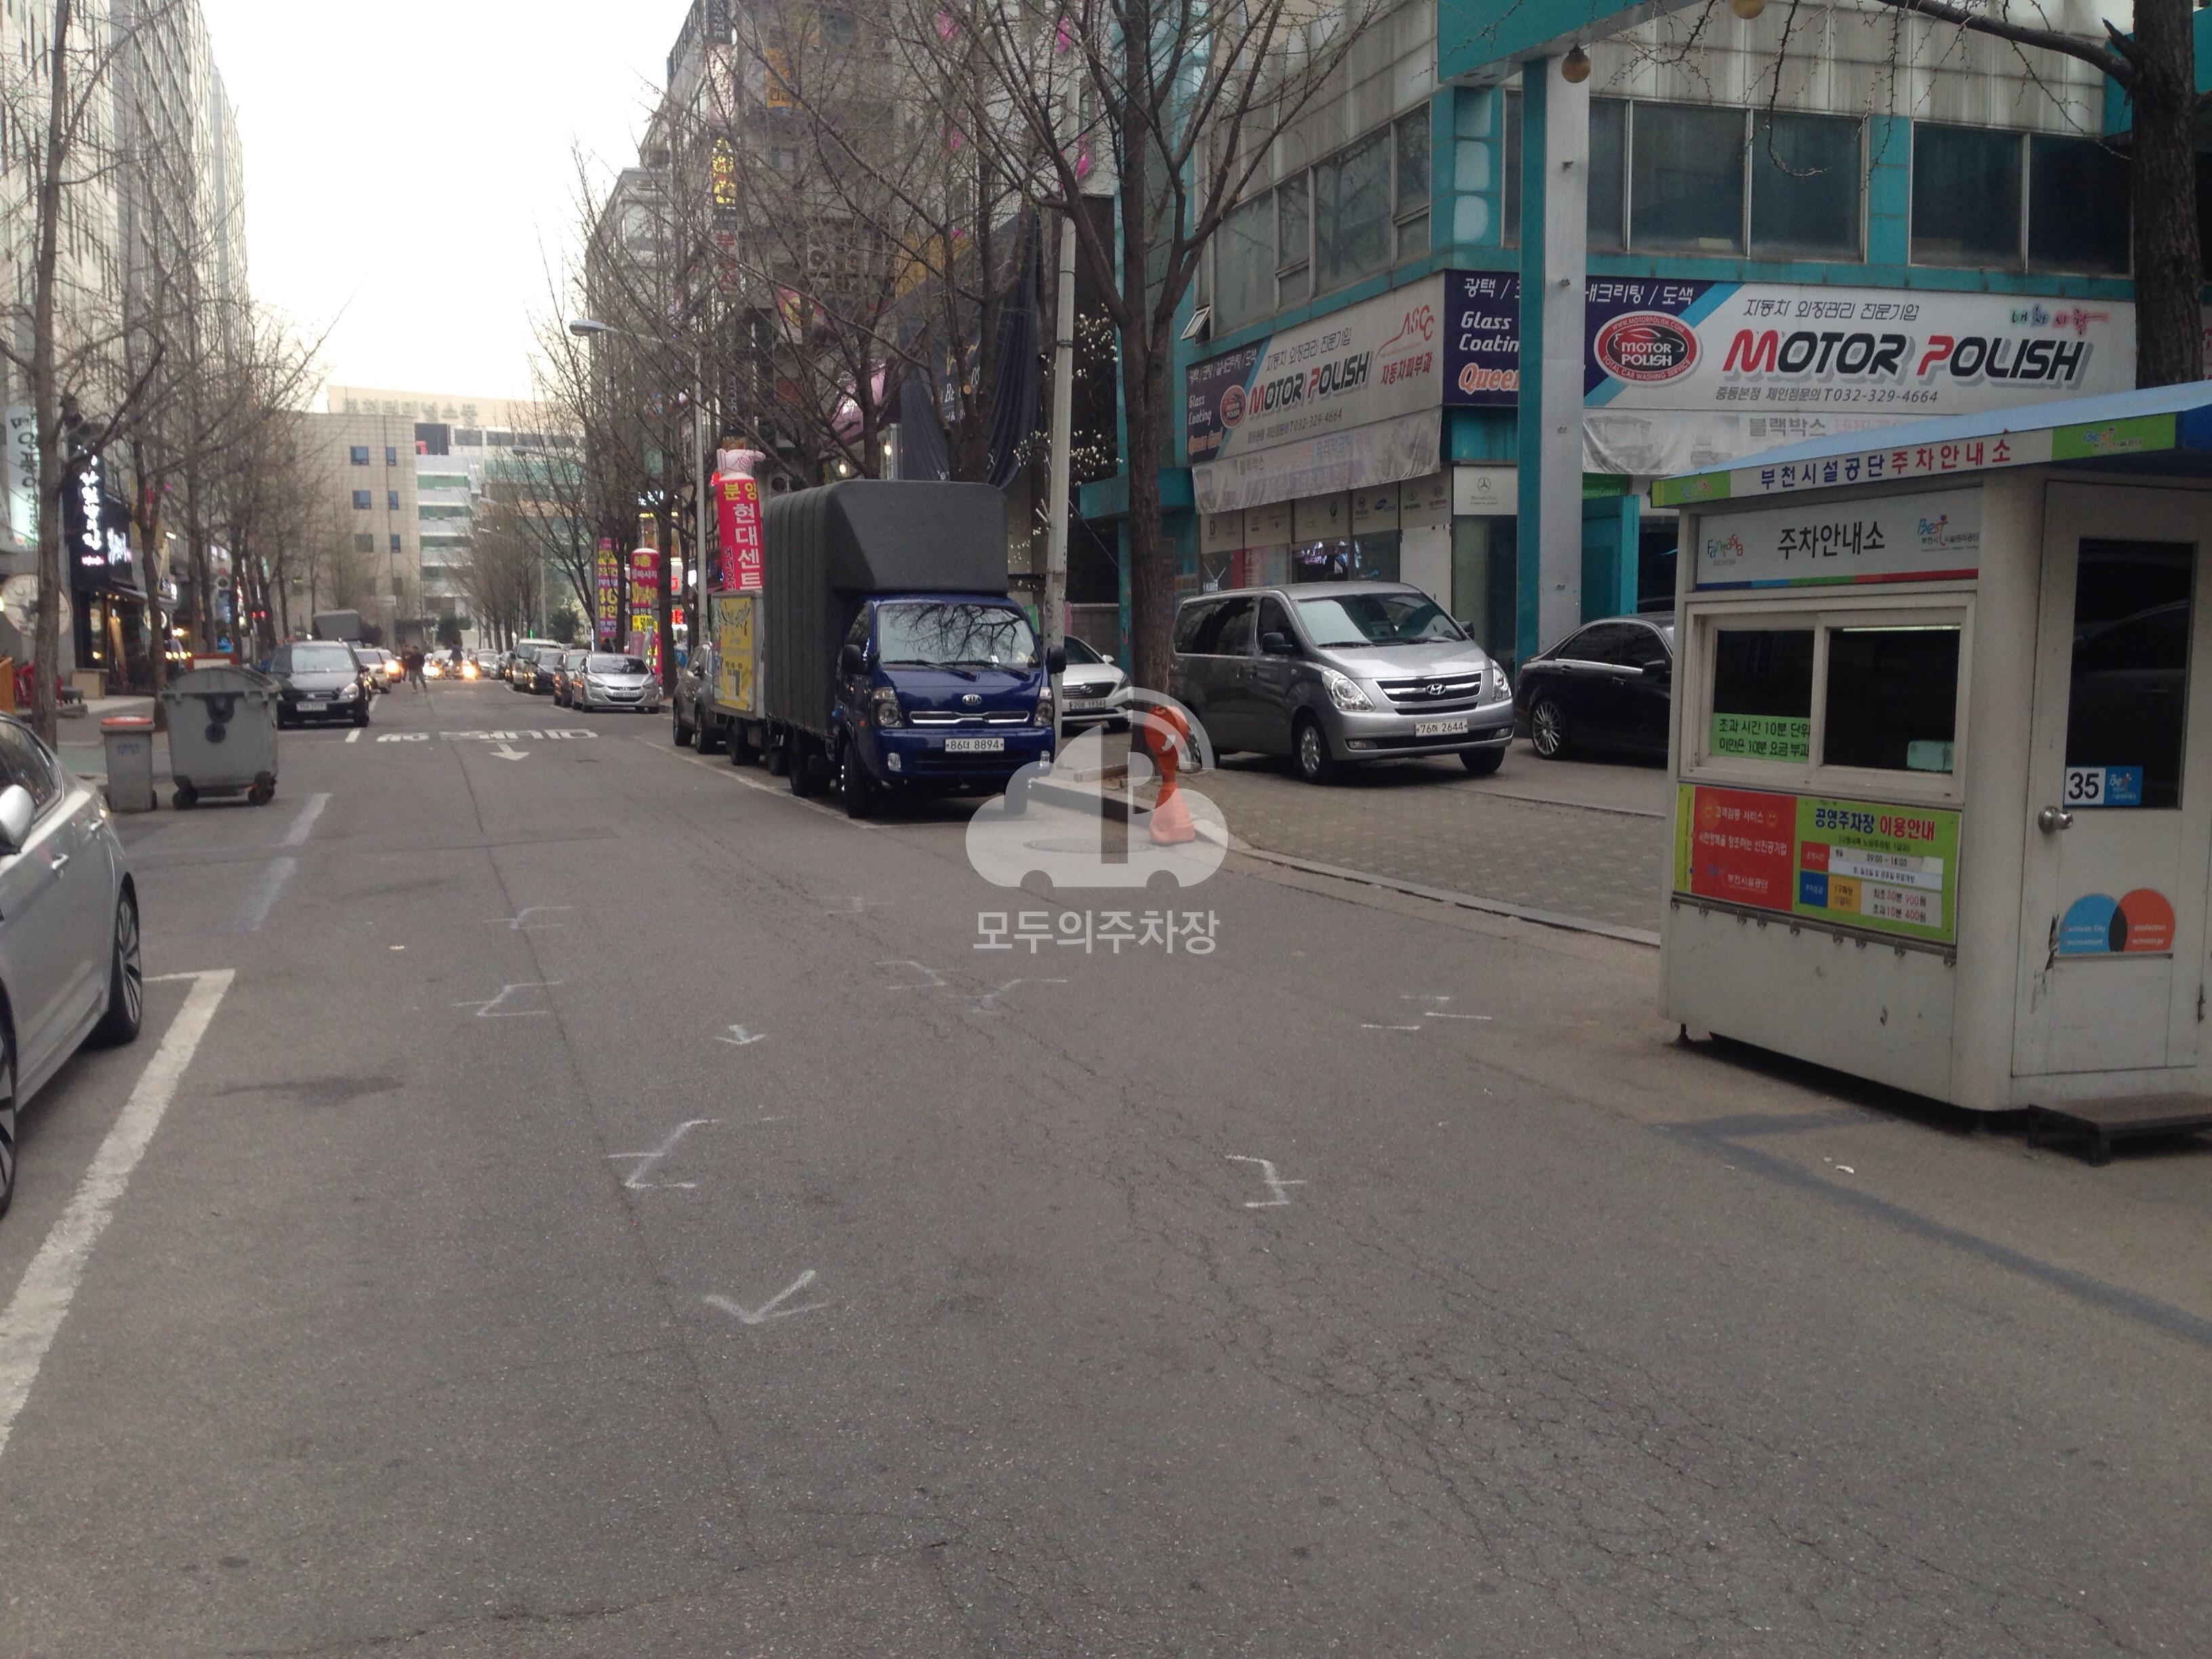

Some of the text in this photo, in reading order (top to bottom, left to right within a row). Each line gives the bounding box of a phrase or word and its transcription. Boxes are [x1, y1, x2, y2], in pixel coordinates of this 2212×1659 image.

[1464, 278, 1496, 298] 광택
[1662, 286, 1694, 305] 도색
[1743, 298, 1791, 317] 자동차
[1460, 310, 1513, 330] Glass
[1458, 333, 1519, 352] Coatin
[1621, 342, 1672, 353] MOTOR
[1621, 353, 1673, 367] POLISH
[1722, 329, 2087, 382] MOTOR POLISH
[1380, 350, 1433, 386] 자동차피부과
[1621, 369, 1635, 380] CAR
[1249, 350, 1372, 415] MOTOR POLISH
[1189, 409, 1212, 426] Coating
[1748, 416, 1827, 437] 블랙박스
[1761, 439, 2011, 490] 부천시설공단 주차안내소
[724, 482, 758, 501] 분양
[1777, 520, 1885, 560] 주차안내소
[1441, 721, 1464, 733] 2644
[1719, 718, 1738, 733] 초과
[1742, 720, 1761, 735] 시간
[1765, 722, 1787, 737] 10분
[974, 738, 1000, 750] 8894
[1719, 737, 1809, 759] 미만은 10분 요금 부과
[2068, 771, 2100, 800] 35
[1742, 809, 1764, 823] 서비스
[1815, 807, 1936, 842] 공영주차장 이용안내
[1905, 894, 1927, 907] 900원
[1905, 909, 1927, 923] 400원
